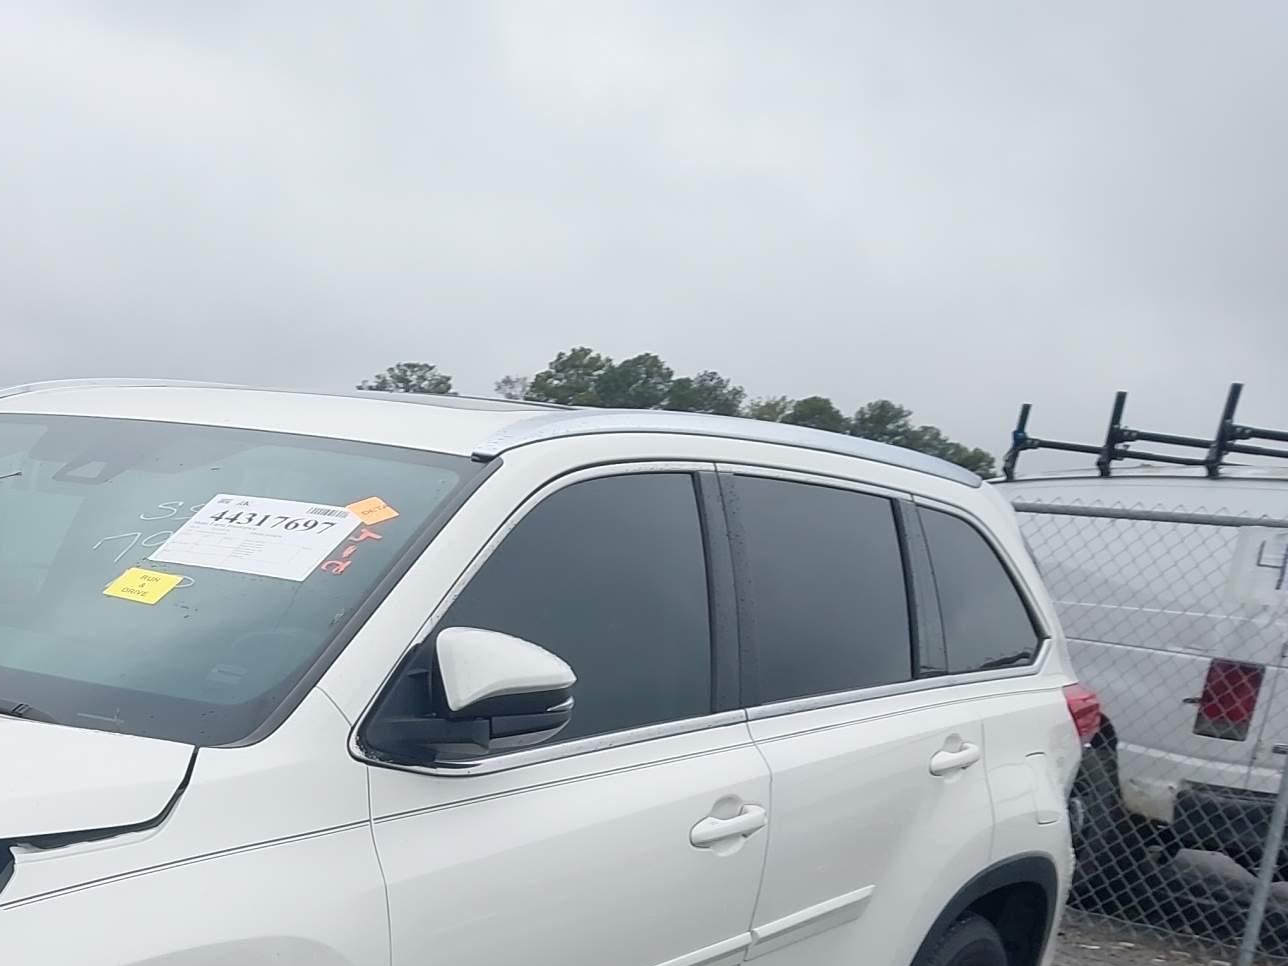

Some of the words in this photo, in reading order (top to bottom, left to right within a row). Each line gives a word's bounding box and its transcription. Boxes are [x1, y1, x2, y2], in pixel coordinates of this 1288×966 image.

[209, 510, 336, 535] 44317697
[140, 574, 161, 583] RUN
[120, 587, 148, 597] DRIVE
